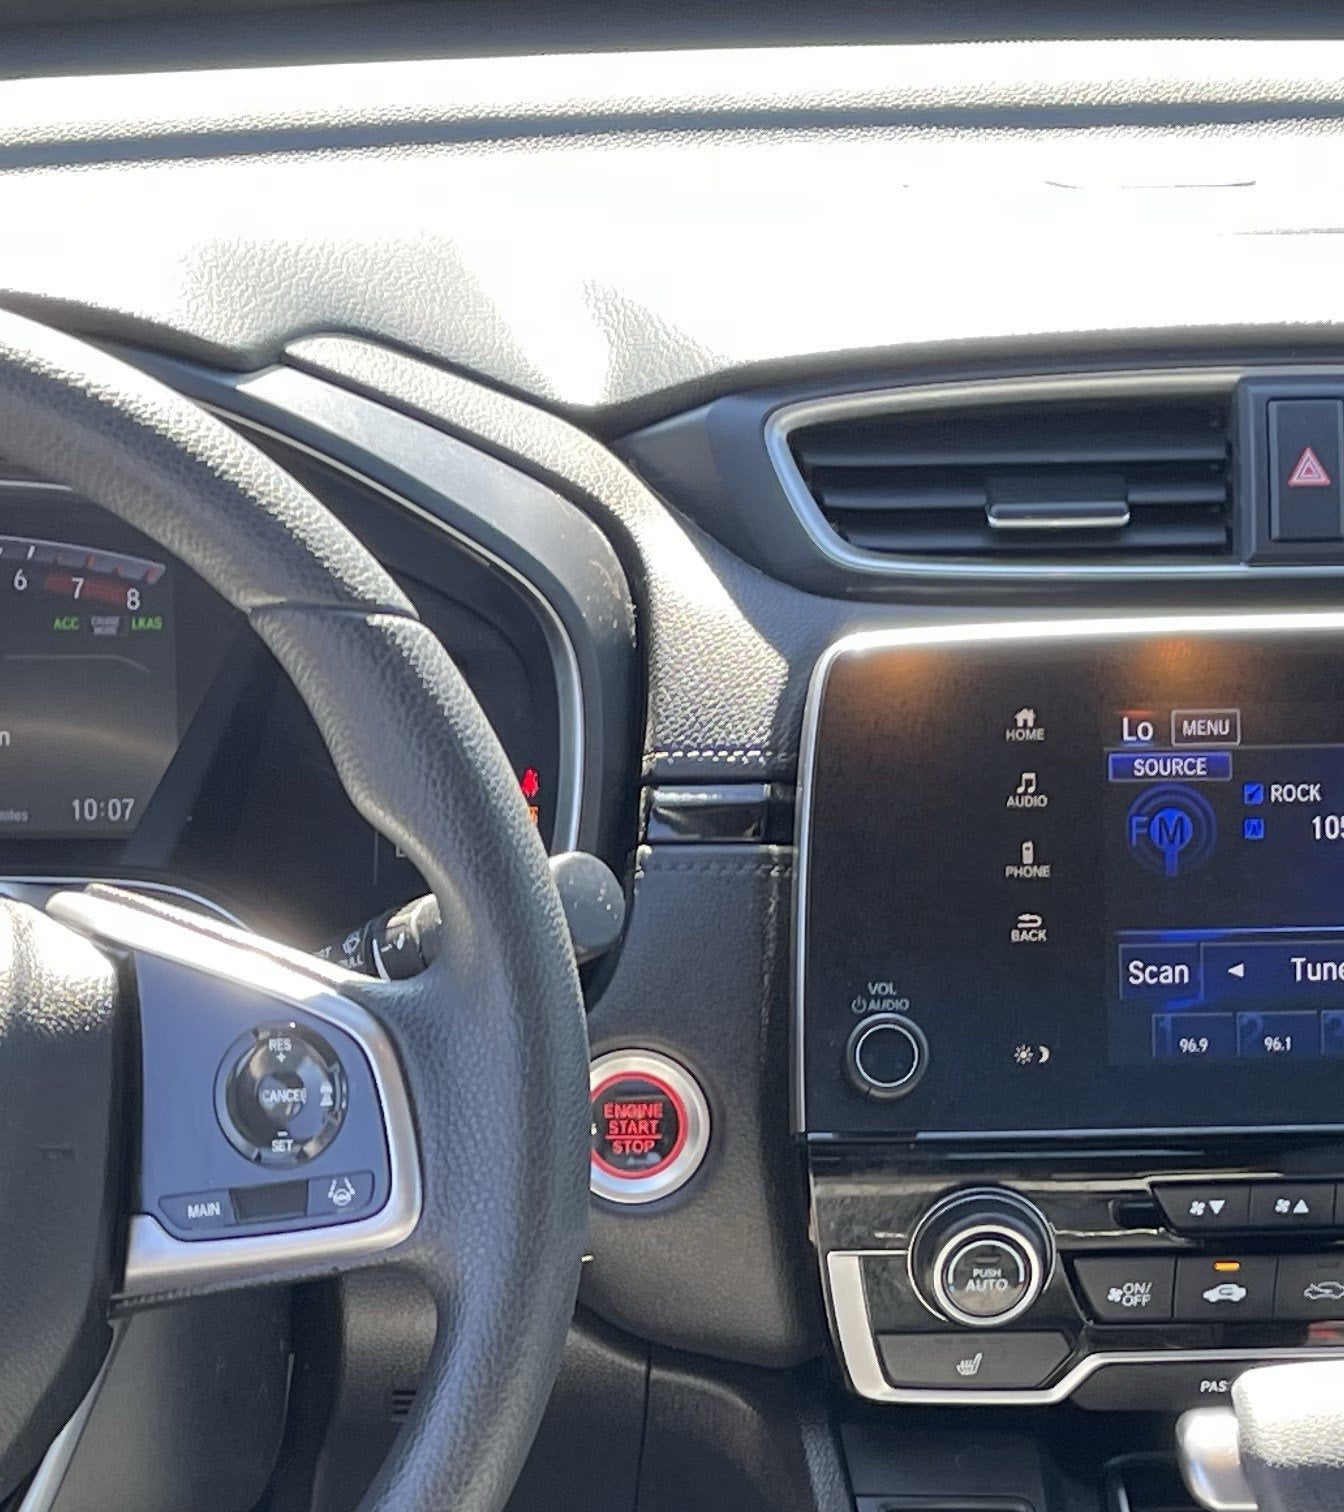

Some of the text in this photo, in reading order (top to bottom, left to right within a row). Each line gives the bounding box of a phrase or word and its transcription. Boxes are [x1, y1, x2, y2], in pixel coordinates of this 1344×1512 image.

[13, 569, 27, 590] 6
[71, 577, 84, 599] 7
[127, 588, 140, 610] 8
[53, 616, 79, 630] ACC
[1005, 728, 1045, 742] HOME
[1122, 716, 1154, 741] Lo
[1182, 718, 1231, 737] MENU
[1133, 756, 1207, 778] SOURCE
[1270, 783, 1322, 803] ROCK
[72, 798, 136, 821] 10:07
[1006, 795, 1048, 809] AUDIO
[1130, 814, 1183, 847] FM
[1005, 865, 1051, 879] PHONE
[1010, 928, 1047, 943] BACK
[1127, 960, 1191, 985] Scan
[867, 982, 897, 997] VOL
[867, 998, 910, 1012] AUDIO
[268, 1038, 293, 1051] RES
[1178, 1036, 1209, 1054] 96.9
[1263, 1035, 1292, 1052] 96.1
[603, 1102, 664, 1120] ENGINE
[608, 1119, 662, 1135] START
[271, 1139, 295, 1153] SET
[612, 1138, 656, 1155] STOP
[187, 1202, 221, 1218] MAIN
[973, 1268, 1003, 1278] PUSH
[965, 1278, 1009, 1293] AUTO
[1122, 1282, 1153, 1296] ON/
[1122, 1294, 1152, 1307] OFF
